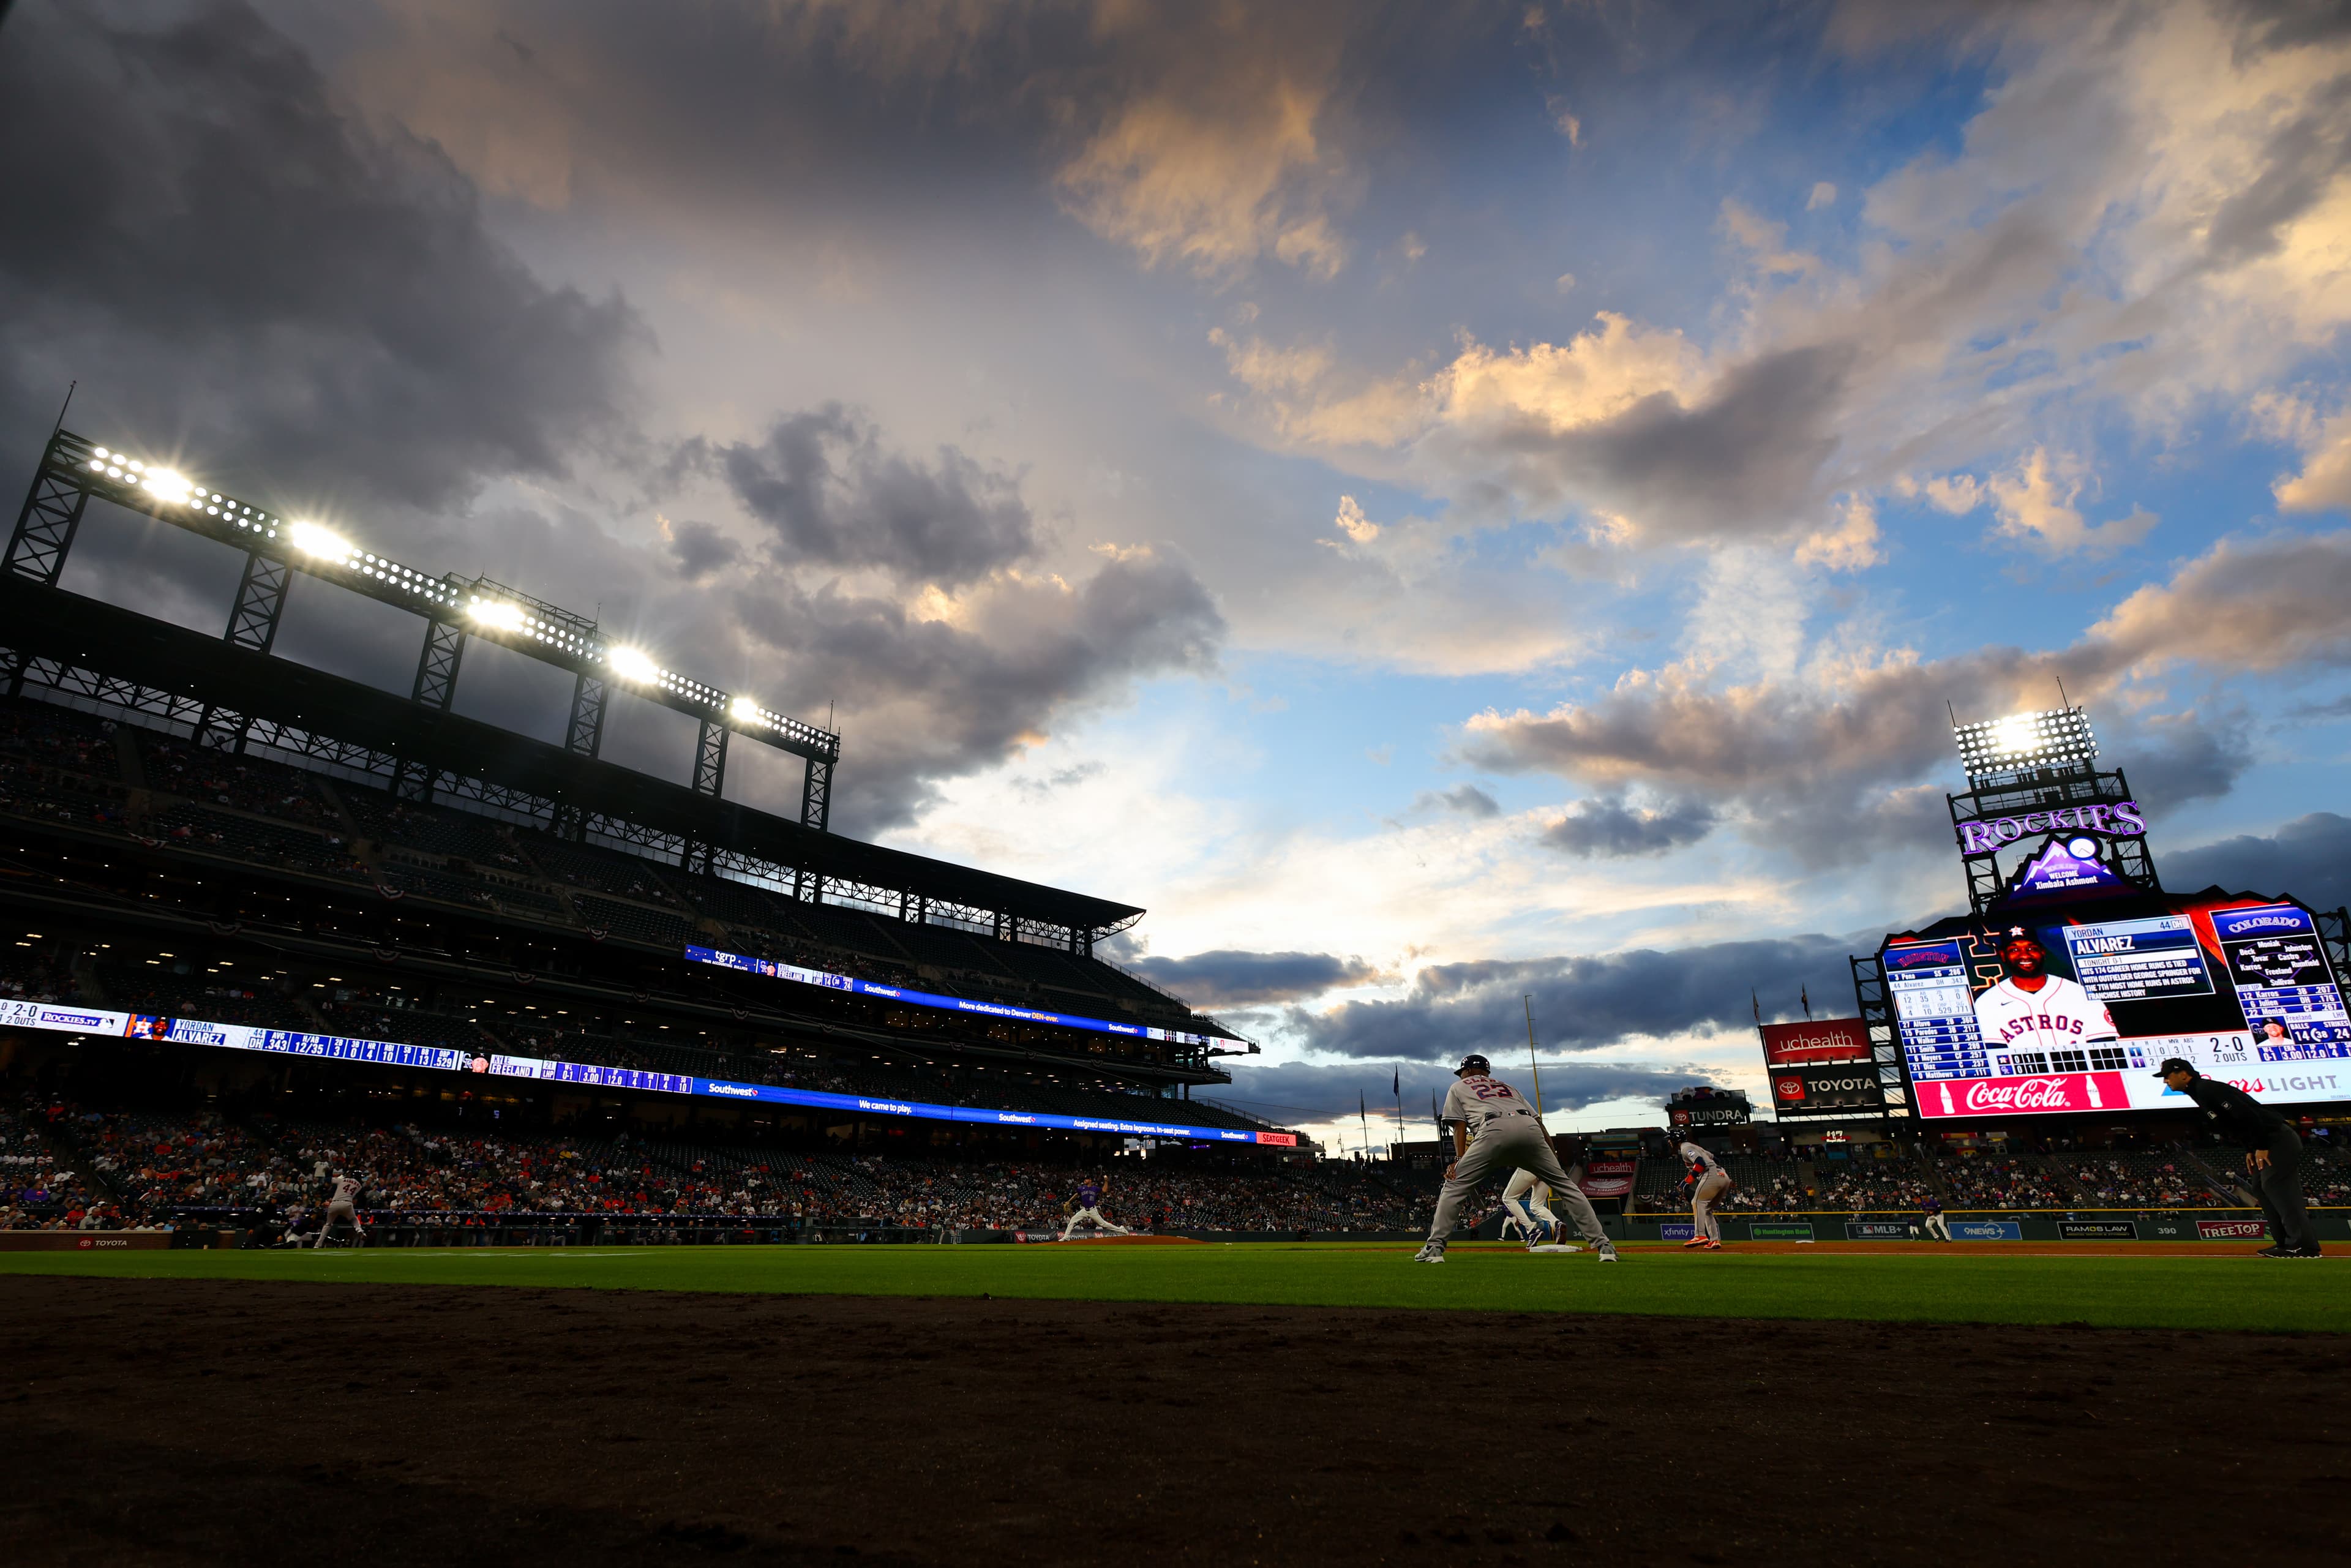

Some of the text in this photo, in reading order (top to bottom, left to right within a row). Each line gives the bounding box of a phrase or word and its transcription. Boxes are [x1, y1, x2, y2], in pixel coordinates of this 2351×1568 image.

[1956, 800, 2146, 854] ROCKIES
[2049, 870, 2078, 879] WELCOME
[2034, 876, 2098, 890] Ximbala Ashmont
[2228, 917, 2301, 933] COLORADO
[2072, 928, 2103, 938] YORDAN
[2077, 936, 2135, 954] ALVAREZ
[715, 950, 736, 964] tgrp
[1897, 952, 1949, 967] HOUSTON
[2107, 965, 2129, 973] CAREER
[779, 970, 803, 981] FREELAND
[2099, 973, 2132, 983] OUTFIELDER
[2157, 969, 2188, 978] SPRINGER
[864, 984, 896, 997] Southwest
[2088, 991, 2120, 1000] FRANCHISE
[959, 1001, 975, 1010] More
[976, 1004, 1003, 1014] dedicated
[1032, 1013, 1059, 1022] DEN-ever.
[15, 1017, 36, 1026] OUTS
[43, 1013, 97, 1025] ROCKIES.TV
[179, 1020, 214, 1032] YORDAN
[1109, 1023, 1134, 1033] Southwest
[2000, 1015, 2083, 1043] ASTROS
[175, 1031, 223, 1045] ALVAREZ
[302, 1035, 319, 1043] H/AB
[1780, 1031, 1853, 1051] uchealth
[2295, 1032, 2310, 1041] 14
[2334, 1029, 2350, 1038] 24
[249, 1038, 263, 1049] DH
[264, 1039, 287, 1051] .343
[295, 1042, 323, 1054] 12/35
[433, 1057, 452, 1067] .529
[2224, 1052, 2247, 1062] OUTS
[492, 1064, 530, 1076] FREELAND
[563, 1071, 572, 1079] 0-1
[583, 1073, 598, 1082] 3.00
[608, 1075, 622, 1085] 12.0
[2268, 1075, 2337, 1092] LIGHT
[709, 1083, 752, 1096] Southwest
[1809, 1078, 1876, 1092] TOYOTA
[1471, 1084, 1513, 1100] 23
[1967, 1078, 2067, 1109] Coca-Cola
[859, 1100, 870, 1108] We
[897, 1104, 912, 1115] play.
[999, 1114, 1031, 1123] Southwest
[1689, 1108, 1745, 1122] TUNDRA
[1073, 1119, 1098, 1130] Assigned
[1099, 1122, 1119, 1131] seating.
[1120, 1123, 1133, 1131] Extra
[1134, 1124, 1156, 1133] legroom.
[1263, 1134, 1289, 1144] SEATGEEK
[1593, 1163, 1633, 1173] uchealth
[343, 1185, 356, 1195] 44
[1664, 1227, 1689, 1239] xfinity
[2202, 1224, 2260, 1238] TREE TOP
